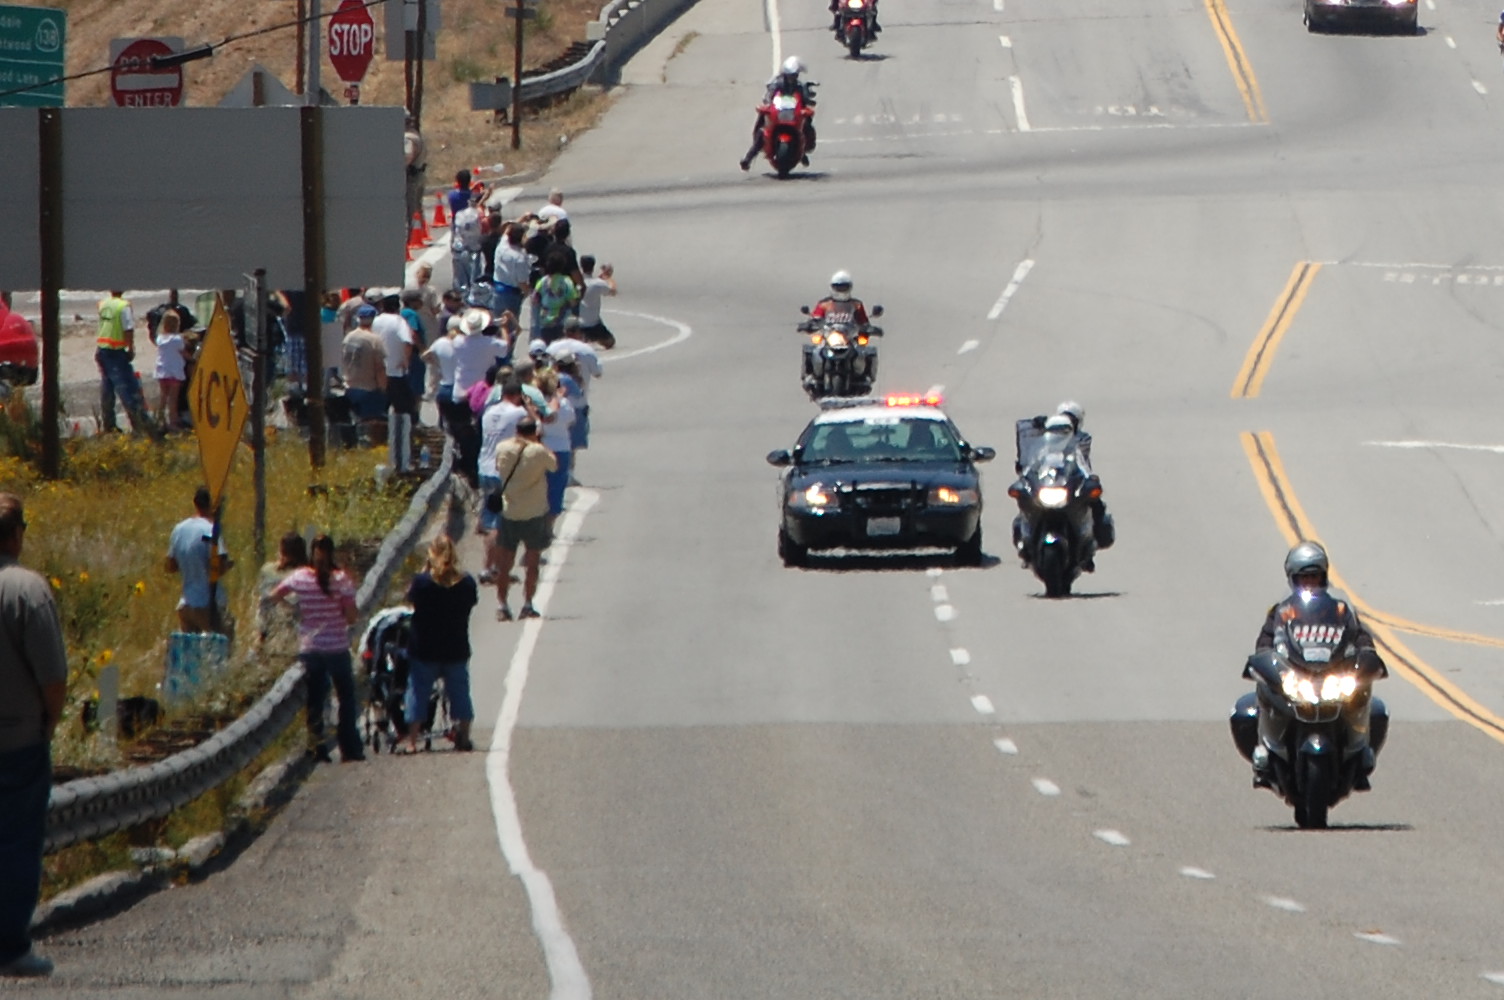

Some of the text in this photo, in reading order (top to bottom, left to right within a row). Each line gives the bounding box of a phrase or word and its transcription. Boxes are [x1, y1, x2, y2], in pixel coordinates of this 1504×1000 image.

[40, 28, 58, 46] 138
[330, 22, 372, 56] STOP
[120, 55, 140, 71] DO
[125, 92, 173, 108] ENTER
[197, 367, 239, 432] ICY
